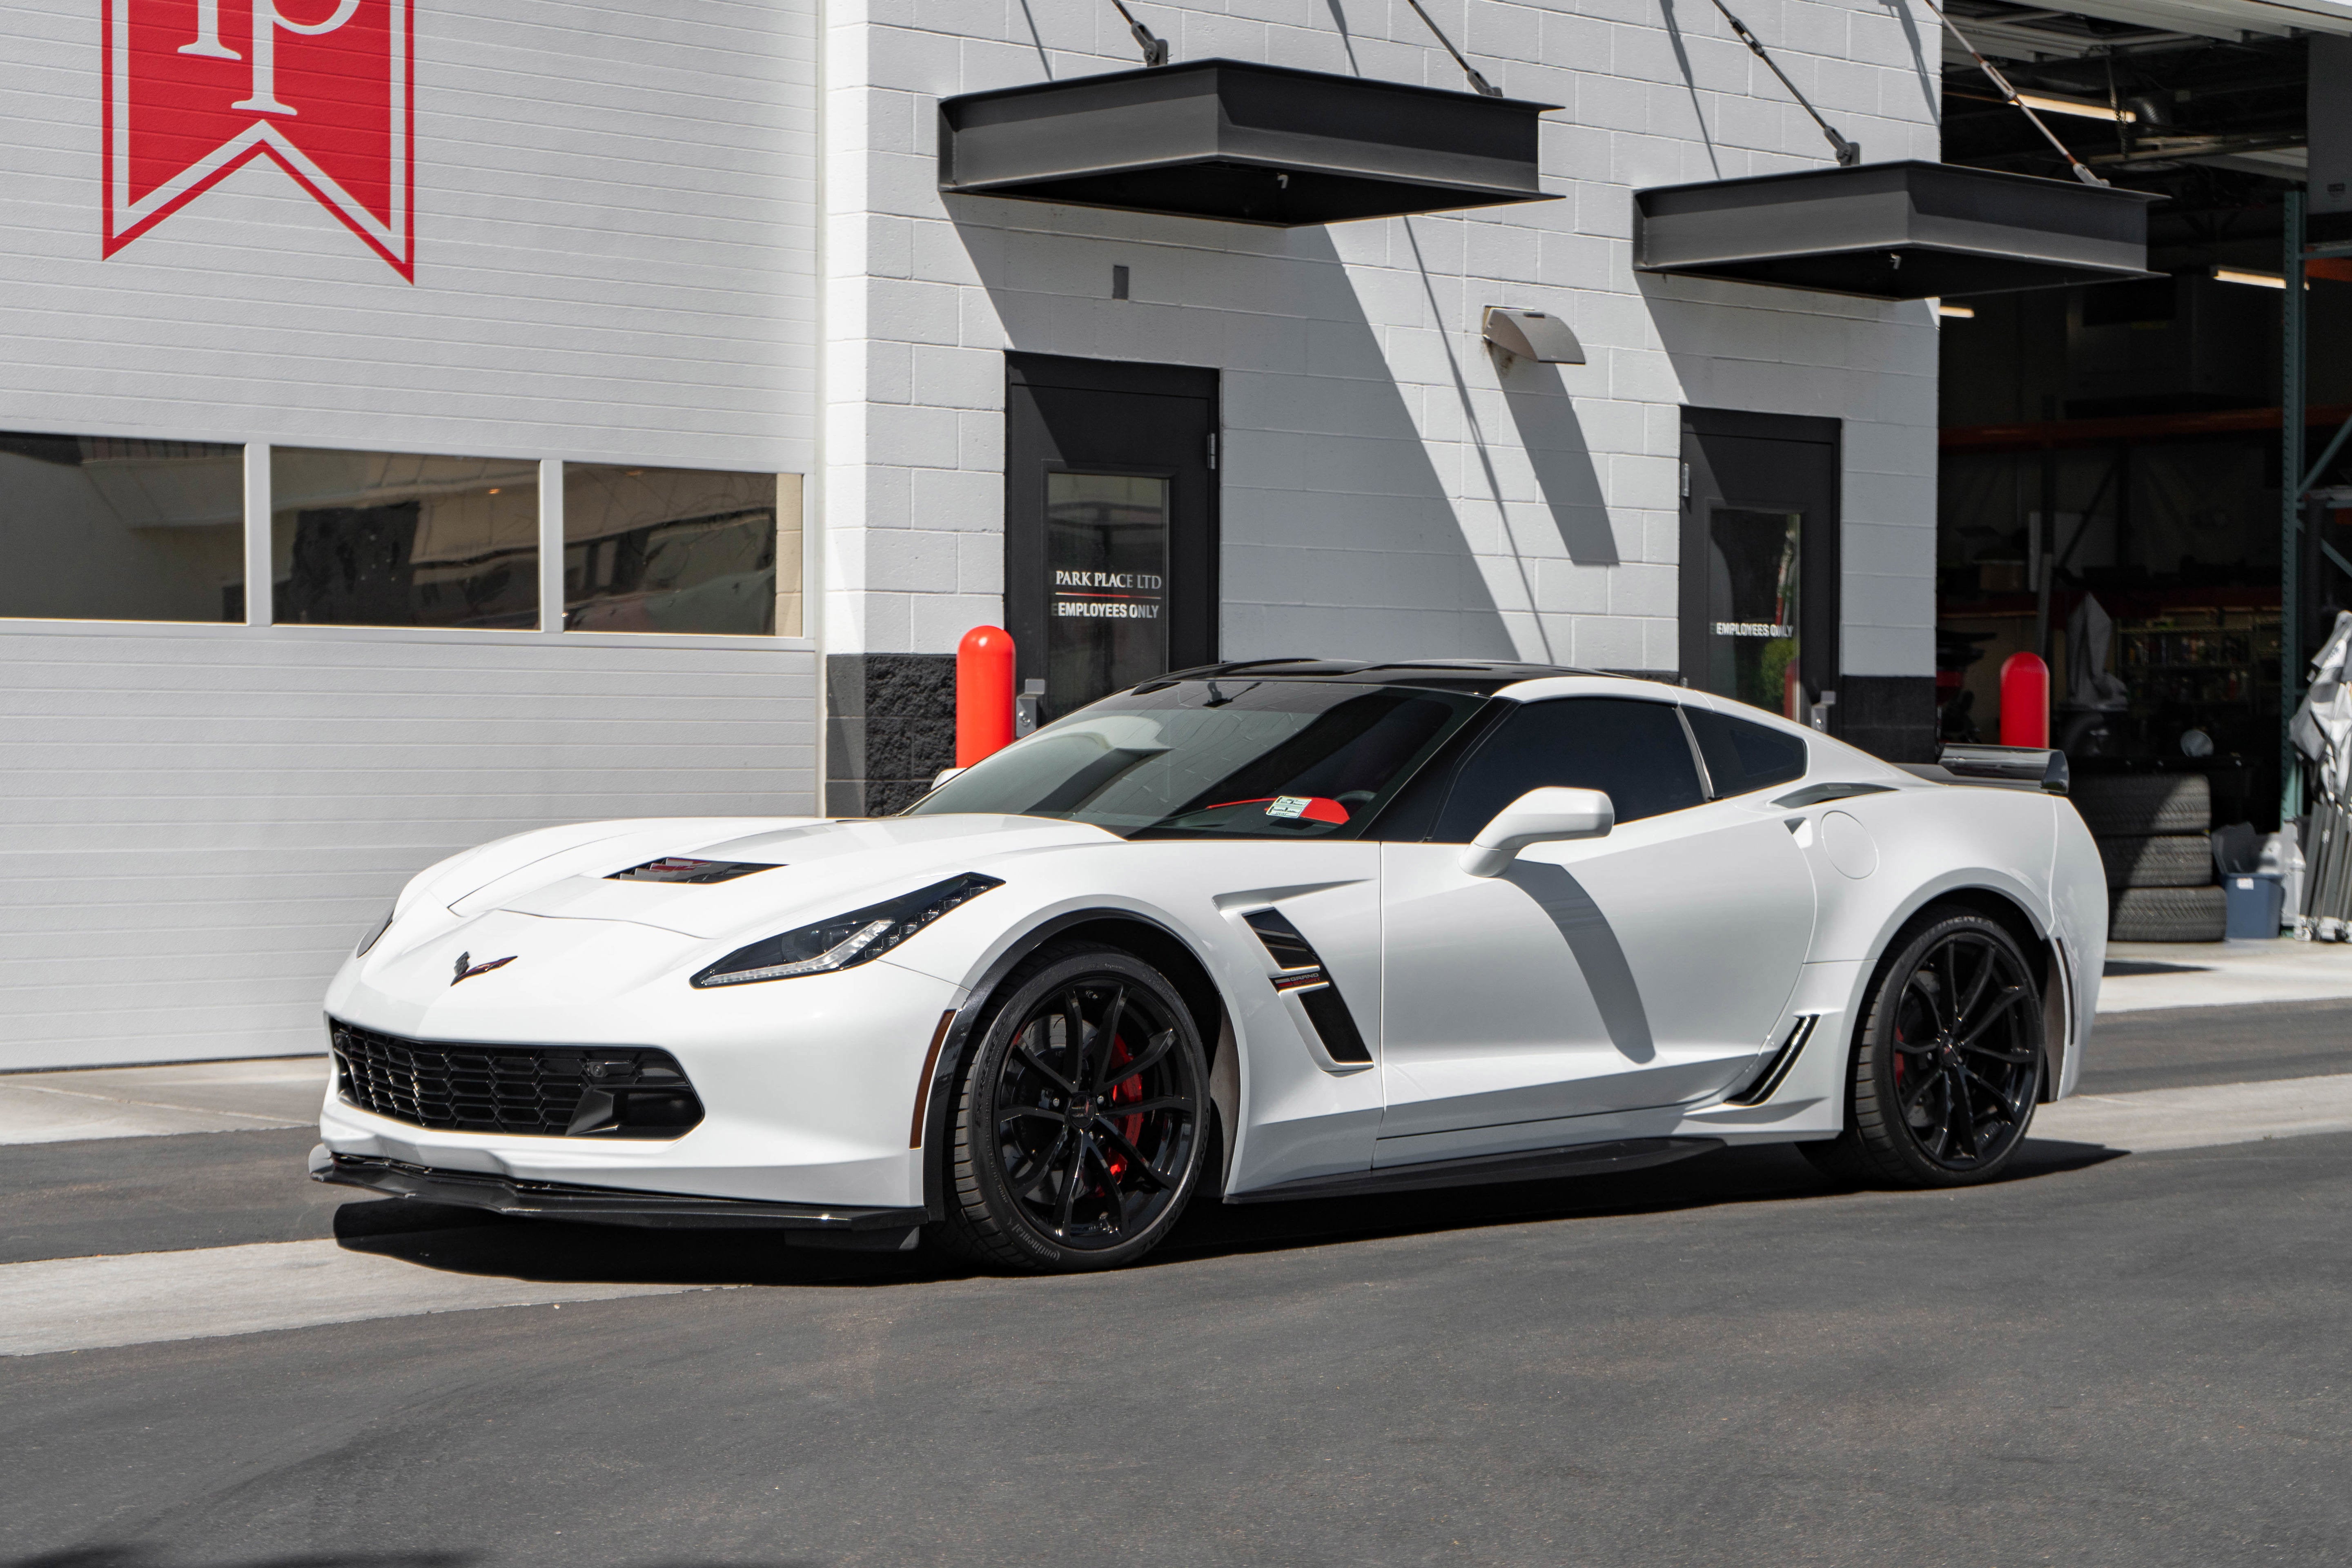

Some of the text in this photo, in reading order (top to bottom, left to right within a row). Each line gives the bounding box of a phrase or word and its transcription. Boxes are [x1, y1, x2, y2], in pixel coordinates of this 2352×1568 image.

[1056, 570, 1162, 589] PARK PLACE LTD
[1058, 602, 1159, 618] EMPLOYEES ONLY
[1716, 622, 1793, 637] EMPLOYEES ONLY
[1290, 973, 1319, 982] GRAND
[1011, 1224, 1060, 1261] Continental
